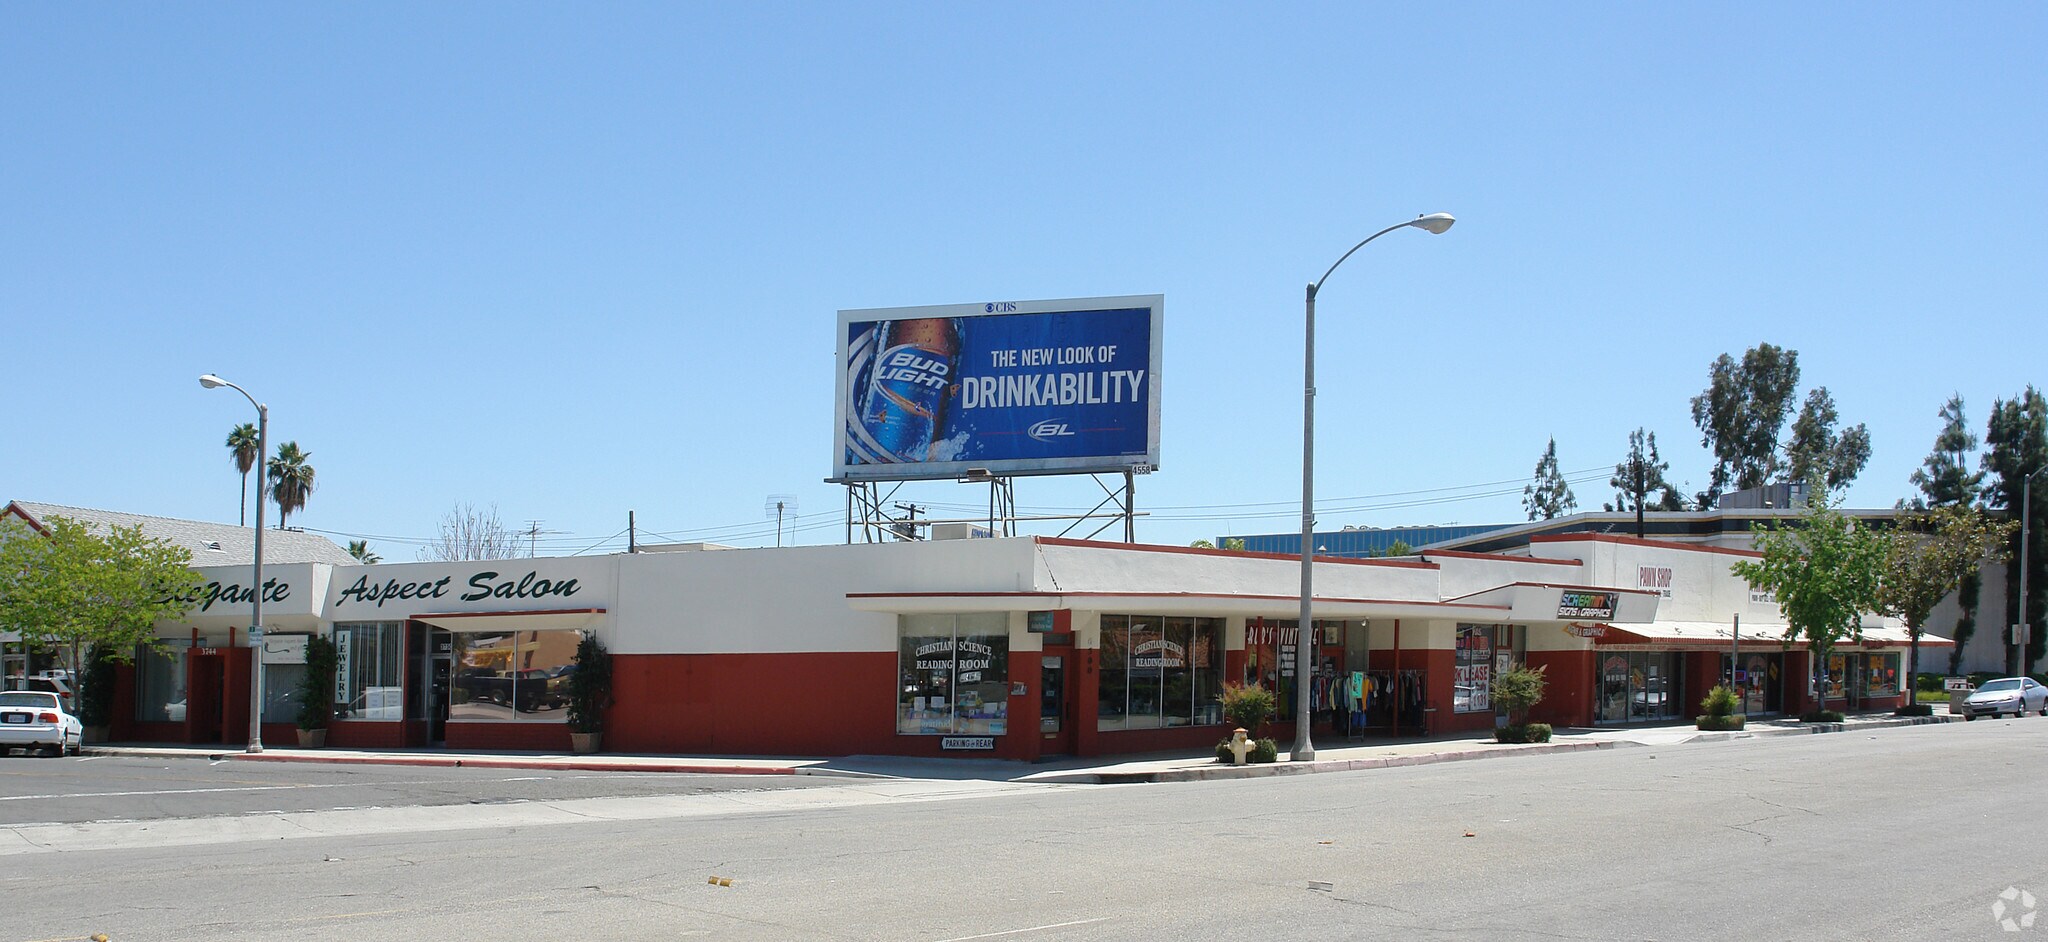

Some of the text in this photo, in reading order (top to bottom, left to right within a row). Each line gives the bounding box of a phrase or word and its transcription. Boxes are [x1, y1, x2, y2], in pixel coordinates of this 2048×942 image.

[996, 302, 1016, 312] CBS
[889, 353, 949, 376] BUD
[991, 345, 1117, 367] THE NEW LOOK OF
[876, 366, 949, 390] LIGHT
[962, 369, 1145, 409] DRINKABILITY
[1034, 424, 1075, 436] BL
[1133, 466, 1151, 475] 4558
[1640, 566, 1672, 588] PAWN SHOP
[335, 570, 582, 608] Aspect Salon
[1558, 607, 1579, 617] SIGNS
[1580, 607, 1611, 618] GRAPHICS
[1280, 627, 1318, 645] VINTE
[1582, 627, 1605, 637] GRAPHICS
[915, 640, 992, 657] CHRISTIAN SCIENCE
[337, 634, 348, 701] JEWELRY
[916, 659, 989, 669] READING ROOM
[1136, 658, 1180, 667] READING ROOM
[945, 739, 970, 748] PARKING
[975, 739, 992, 748] REAR
